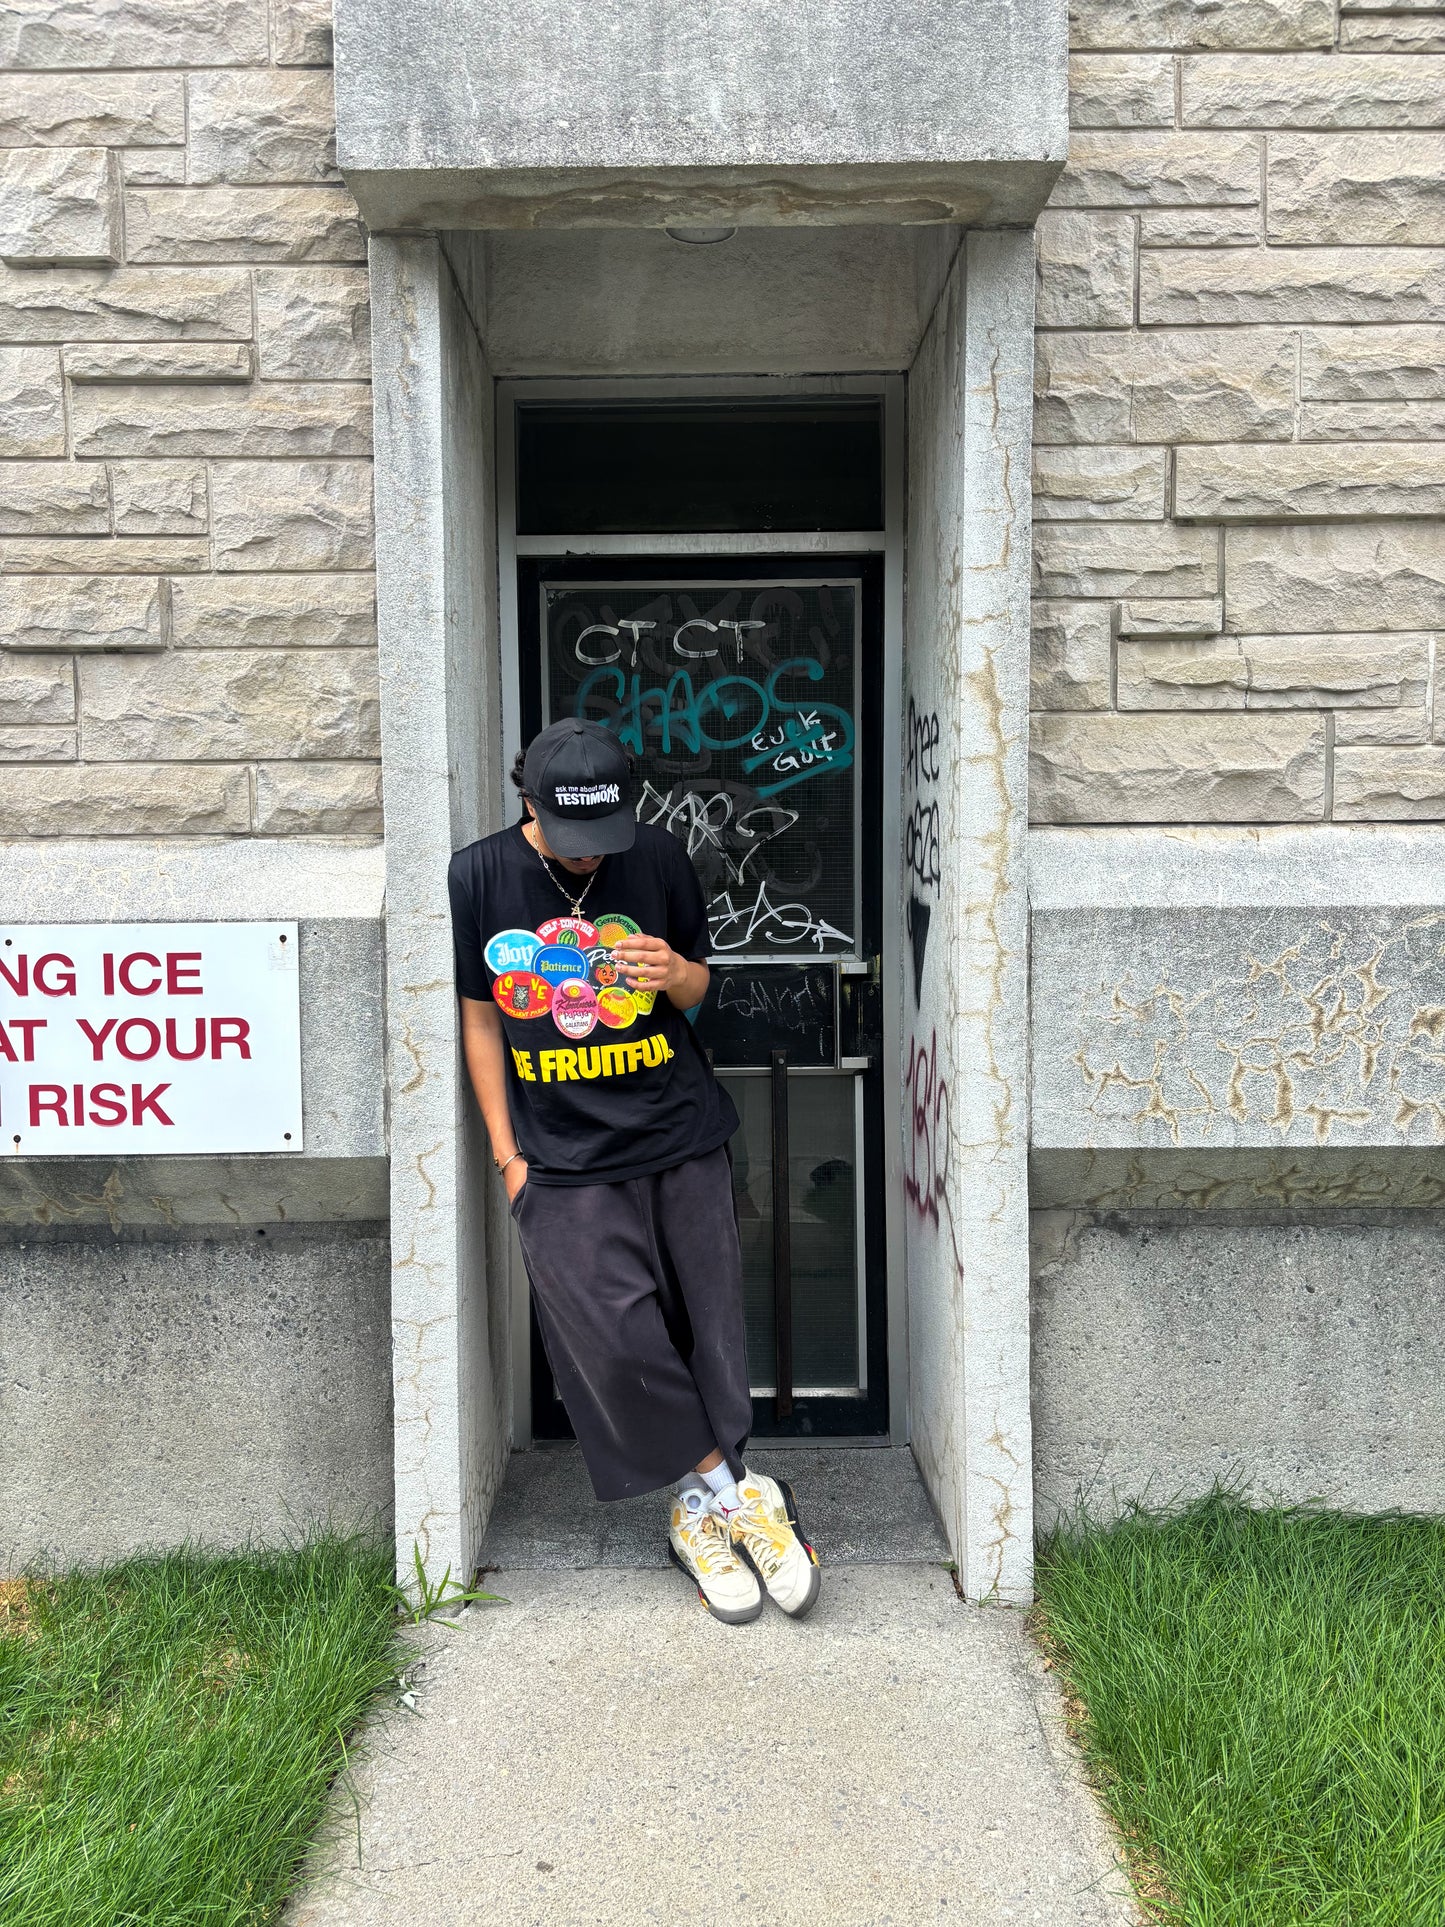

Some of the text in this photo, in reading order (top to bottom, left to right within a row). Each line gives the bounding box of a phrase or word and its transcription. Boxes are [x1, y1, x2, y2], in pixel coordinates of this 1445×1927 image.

[555, 785, 567, 793] ask
[580, 784, 598, 793] about
[538, 918, 595, 938] SELF-CONTROL
[596, 915, 638, 936] Gentlenes
[494, 942, 534, 967] Joy
[541, 960, 582, 973] Patience
[102, 952, 204, 996] ICE
[498, 974, 548, 1000] LOVE
[75, 1016, 252, 1062] YOUR
[511, 1047, 537, 1082] BE
[28, 1082, 175, 1128] RISK
